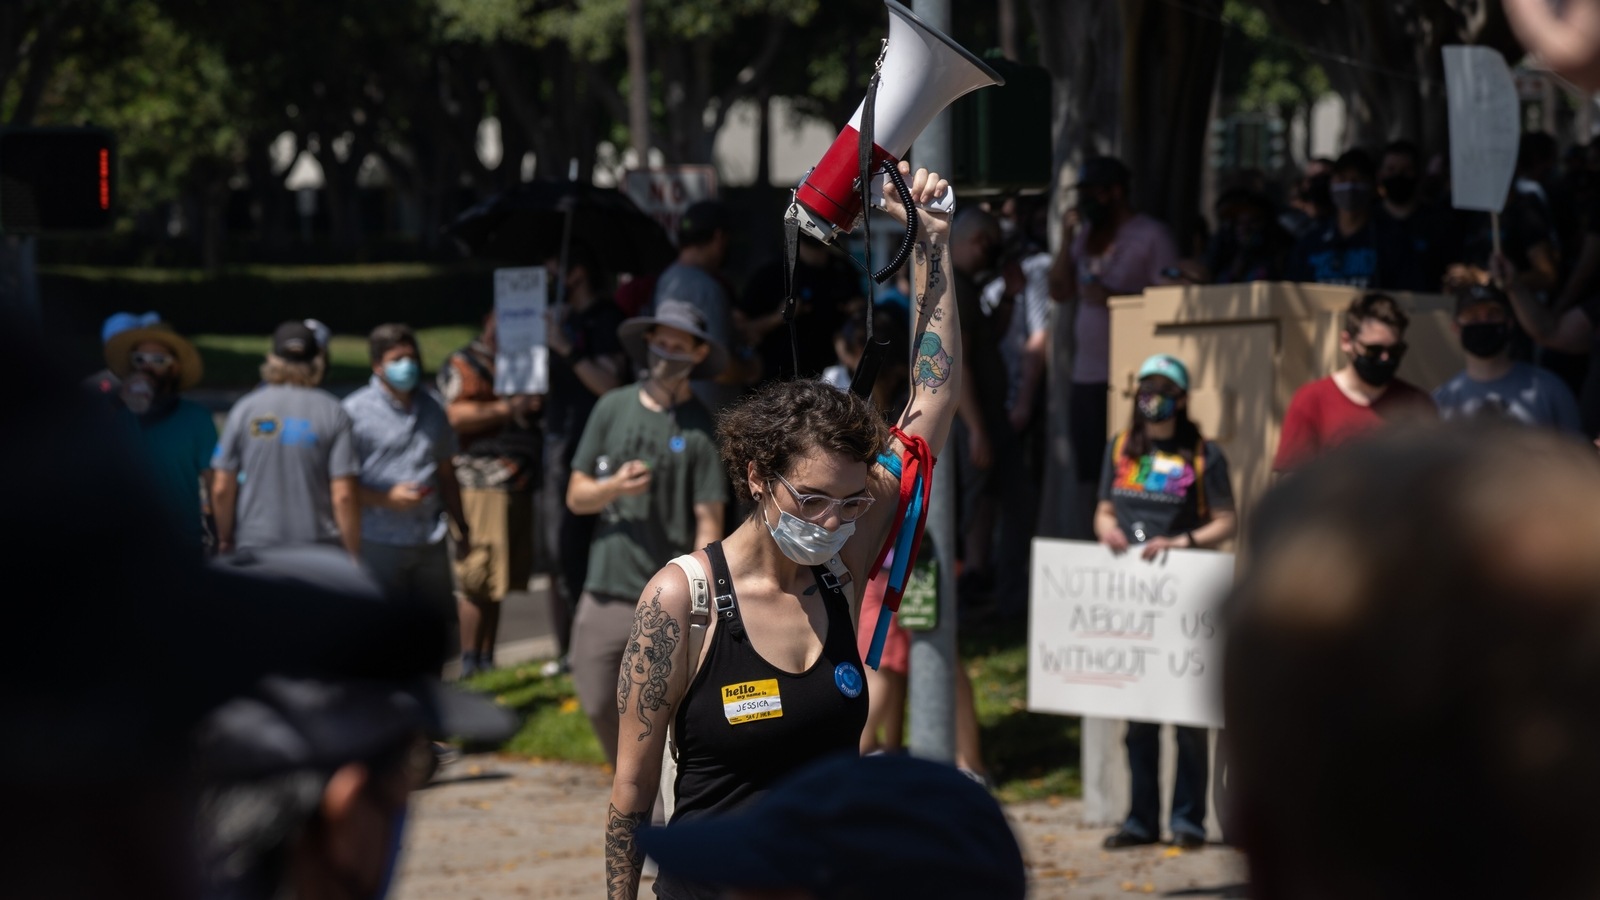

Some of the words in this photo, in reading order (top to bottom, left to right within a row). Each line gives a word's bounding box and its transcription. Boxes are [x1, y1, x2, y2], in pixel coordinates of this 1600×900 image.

[1042, 564, 1181, 607] NOTHING
[1069, 604, 1164, 638] ABOUT
[1180, 610, 1215, 640] US
[1038, 641, 1160, 678] WITHOUT
[1168, 647, 1204, 678] US
[725, 685, 755, 697] hello
[736, 700, 769, 712] JESSICA
